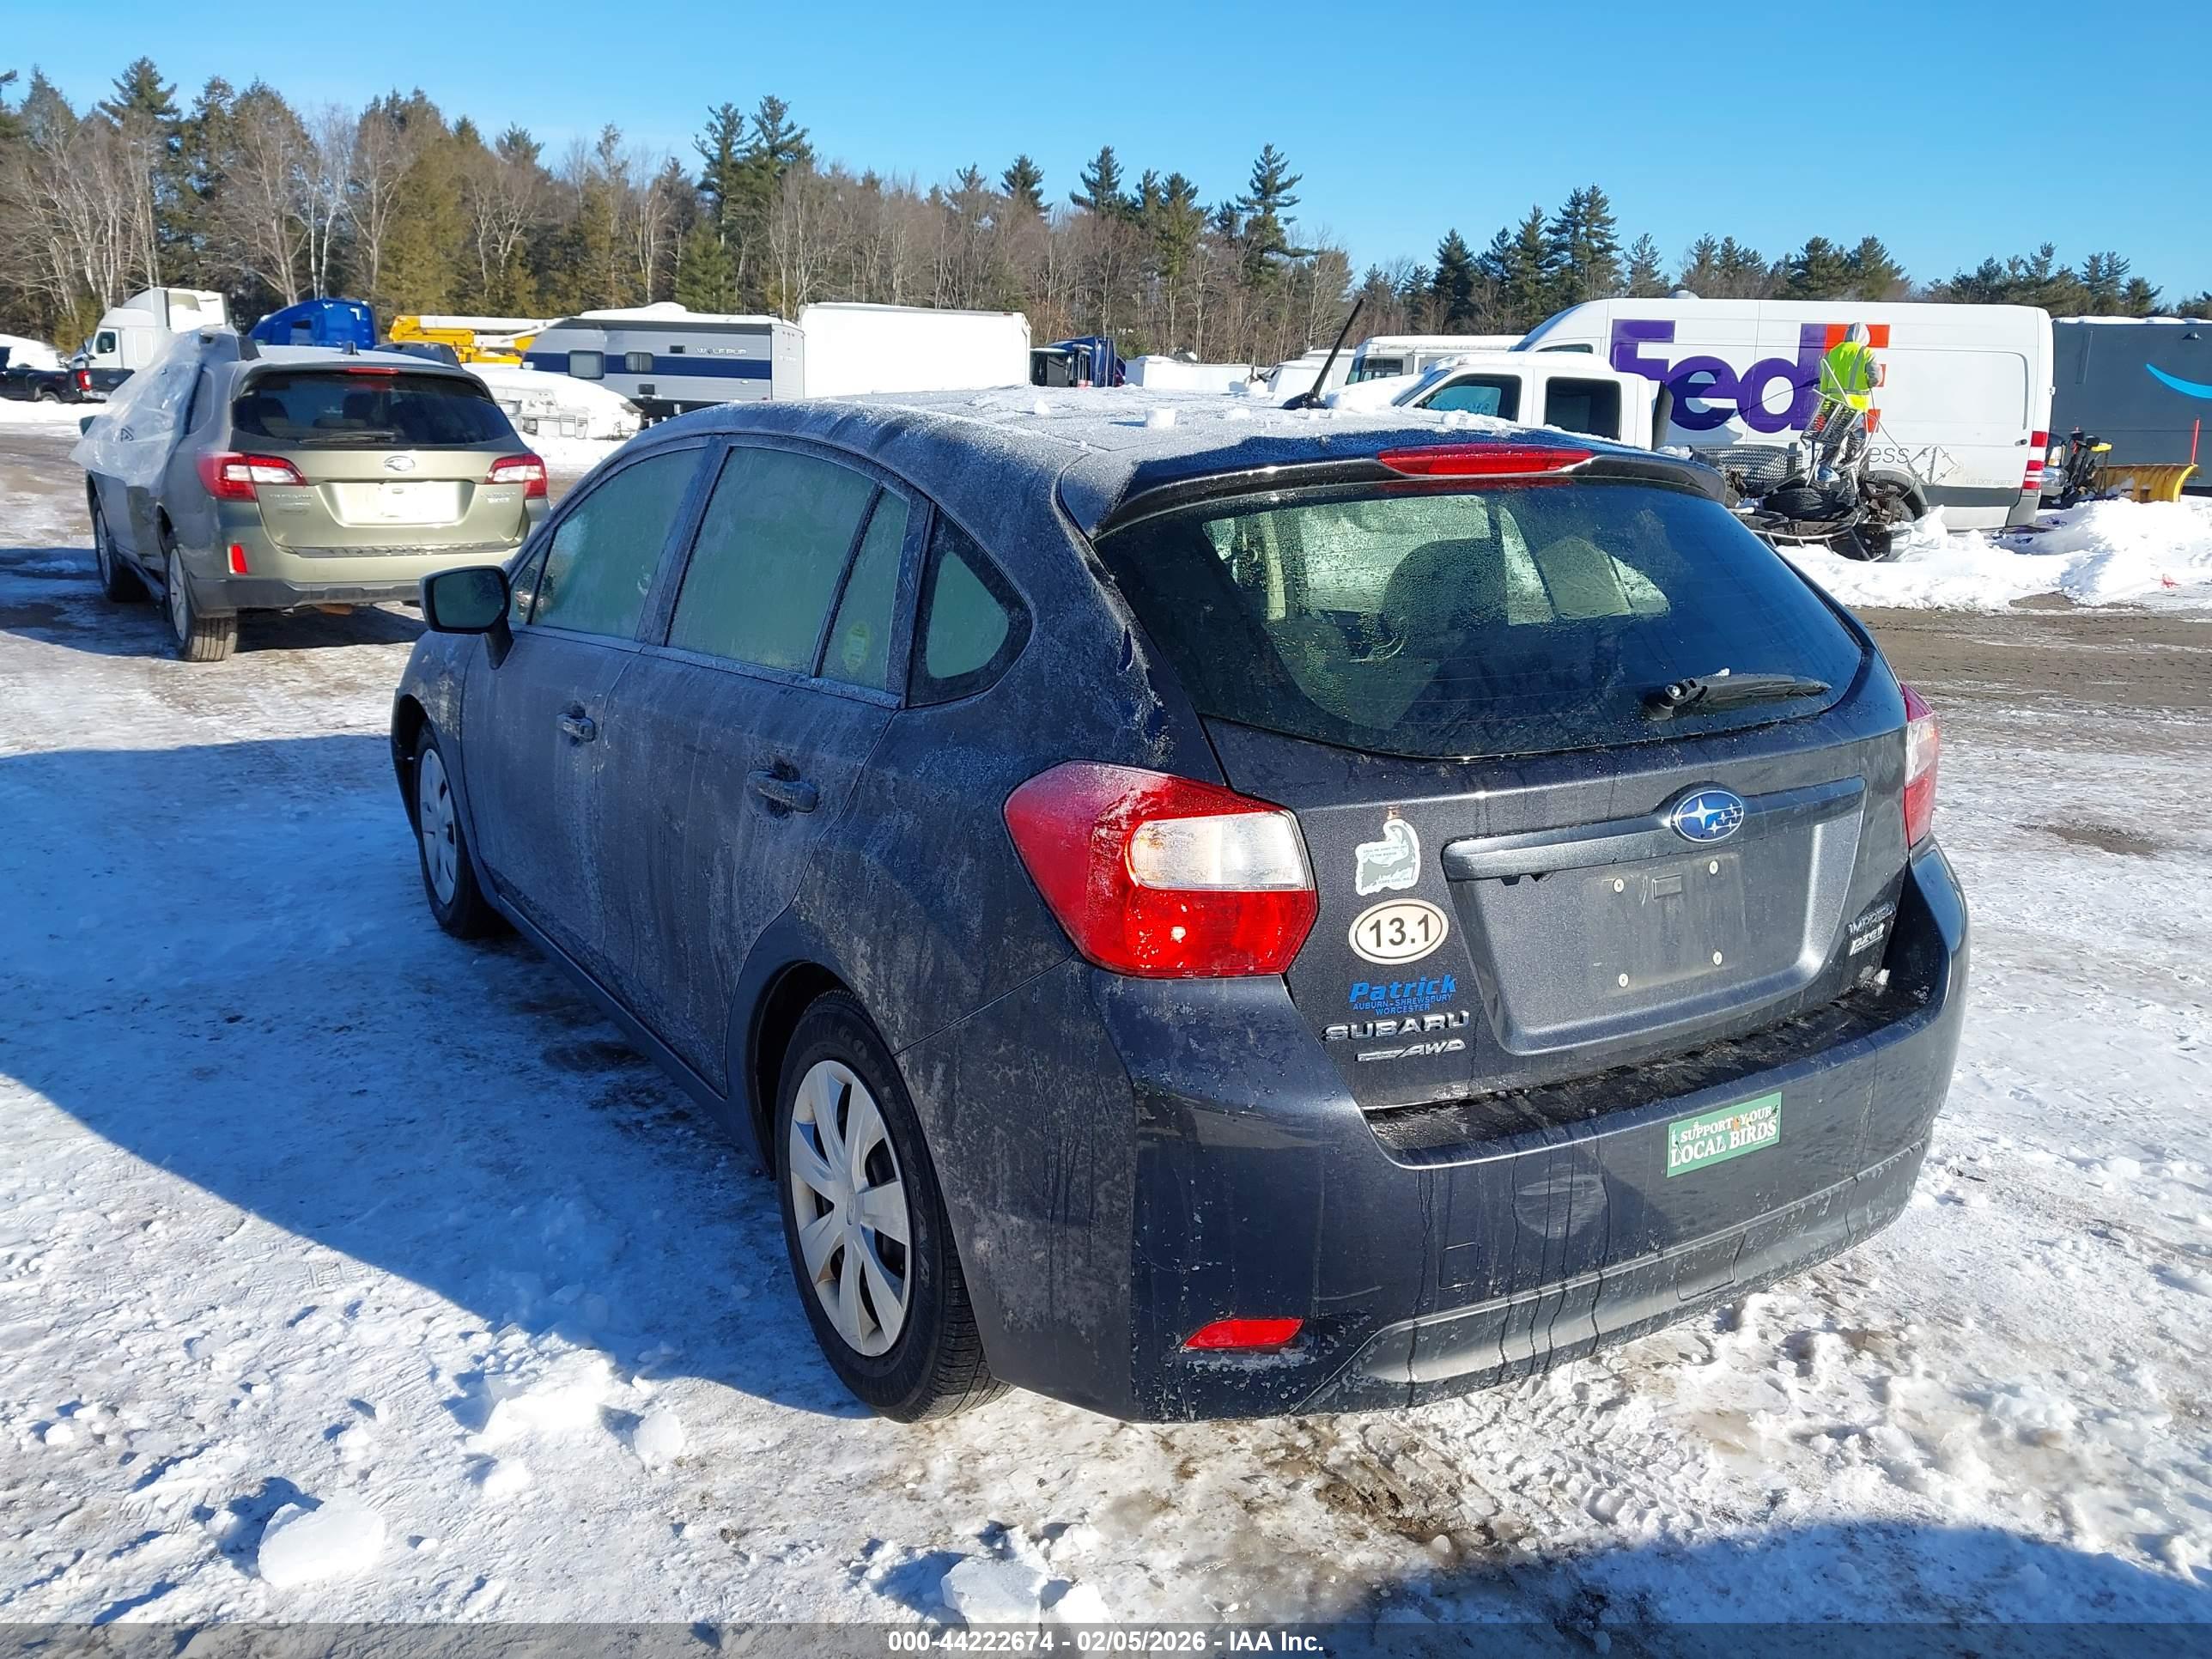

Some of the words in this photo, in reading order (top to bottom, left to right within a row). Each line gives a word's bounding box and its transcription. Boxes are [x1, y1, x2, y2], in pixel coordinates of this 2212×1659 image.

[1369, 914, 1431, 949] 13.1
[1349, 974, 1457, 1003] Patrick
[1375, 1004, 1431, 1016] WORCESTER
[1322, 1011, 1471, 1042] SUBARU
[1398, 1039, 1467, 1059] AWD
[1680, 1117, 1733, 1143] SUPPORT
[1740, 1105, 1772, 1126] YOUR
[1670, 1135, 1727, 1168] LOCAL
[1729, 1118, 1777, 1150] BIRDS
